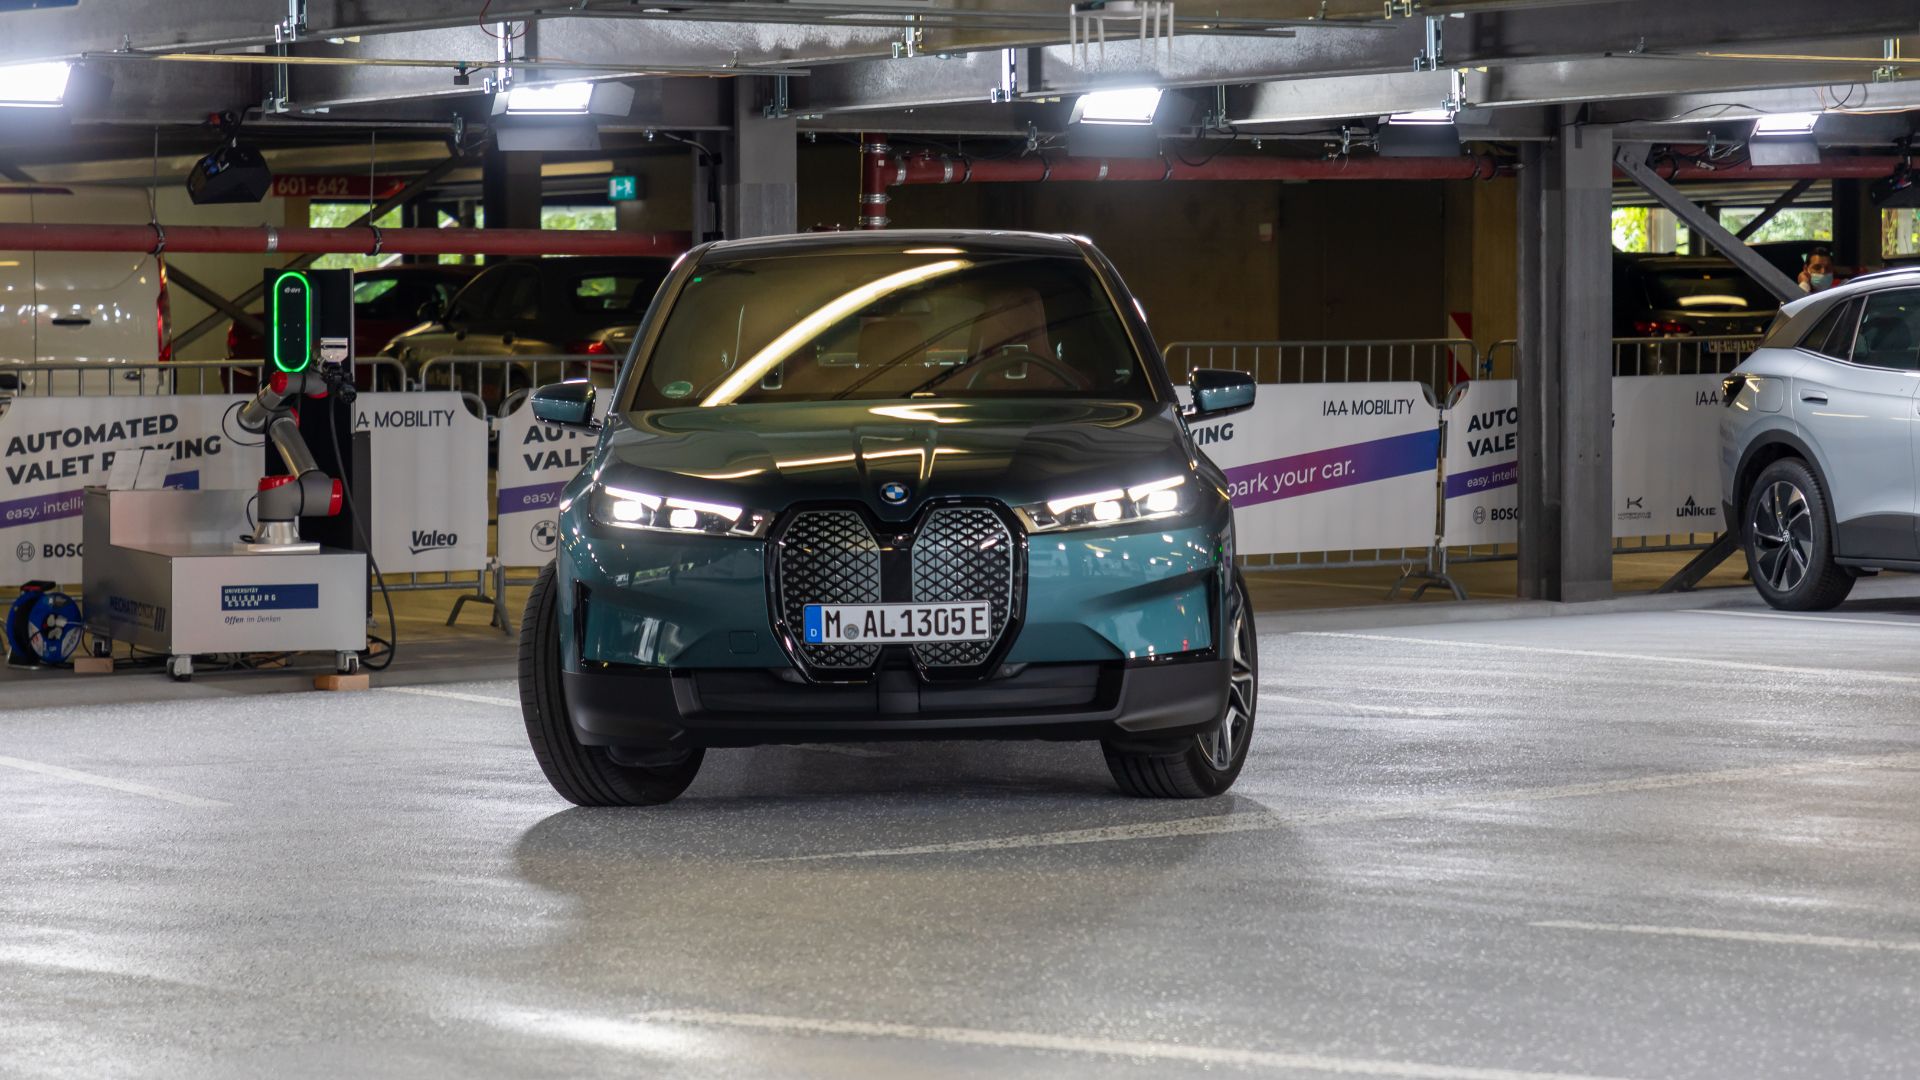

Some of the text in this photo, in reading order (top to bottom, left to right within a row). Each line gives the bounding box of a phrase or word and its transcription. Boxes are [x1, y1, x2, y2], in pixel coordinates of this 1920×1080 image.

[278, 177, 349, 194] 601-642
[1322, 399, 1415, 416] IAA MOBILITY
[1695, 391, 1719, 406] IAA
[374, 410, 455, 428] MOBILITY
[1467, 407, 1518, 433] AUTO
[5, 413, 178, 457] AUTOMATED
[1191, 422, 1234, 446] ING
[1467, 432, 1518, 457] VALE
[5, 450, 97, 485] VALET
[523, 446, 596, 471] VALE
[1272, 466, 1317, 494] your
[1321, 460, 1355, 479] car.
[1467, 467, 1518, 488] easy. intelli
[523, 492, 558, 504] easy.
[6, 497, 84, 520] easy. intelli
[1491, 507, 1519, 521] BOSC
[1676, 506, 1717, 517] UNIKIE
[411, 530, 457, 547] Valeo
[43, 543, 84, 558] BOSC
[225, 616, 244, 624] Offen
[825, 610, 841, 638] M
[810, 627, 818, 637] D
